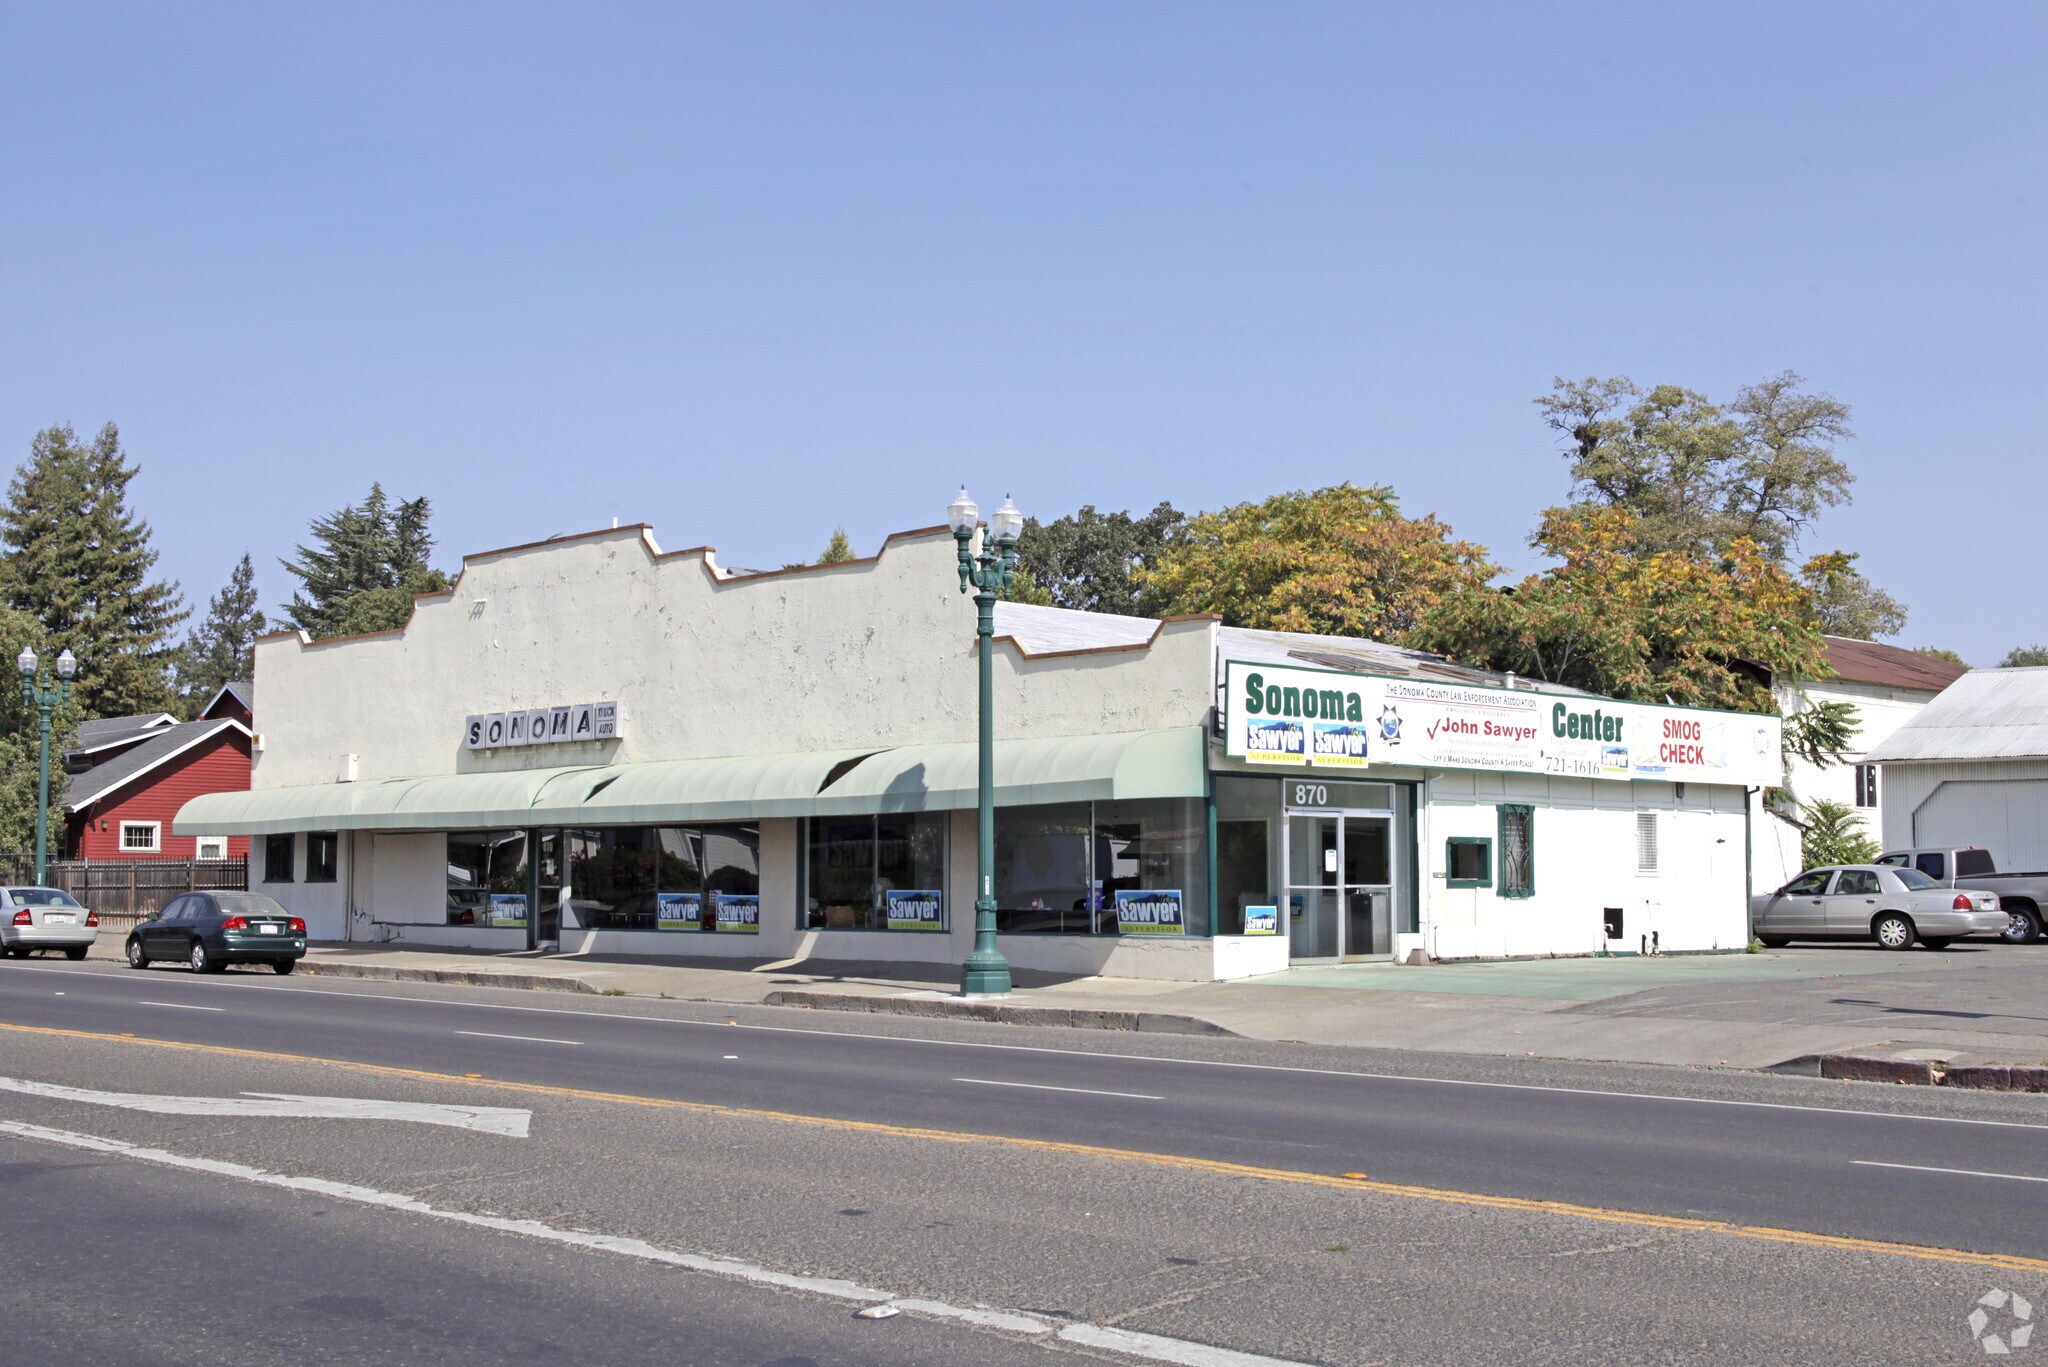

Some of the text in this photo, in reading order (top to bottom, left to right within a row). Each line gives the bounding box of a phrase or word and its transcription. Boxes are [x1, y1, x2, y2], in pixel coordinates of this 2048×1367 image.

[1245, 672, 1363, 723] Sonoma
[1399, 685, 1424, 697] SONOMA
[1426, 687, 1449, 699] COUNTY
[1450, 690, 1462, 700] LAW
[1463, 691, 1502, 704] ENFORCEMENT
[1503, 695, 1537, 708] ASSOCIATION
[469, 710, 591, 745] SONOMA
[1441, 717, 1537, 742] John Sawyer
[1552, 702, 1624, 742] Center
[1663, 718, 1701, 741] SMOG
[1248, 724, 1303, 753] Sawyer
[1314, 728, 1367, 757] Sawyer
[1251, 753, 1302, 762] SUPERVISOR
[1317, 757, 1364, 765] SUPERVISOR
[1461, 756, 1481, 764] SONOMA
[1481, 758, 1499, 766] COUNTY
[1660, 742, 1705, 765] CHECK
[1546, 757, 1600, 775] 721-1616
[1295, 784, 1328, 805] 870
[492, 900, 525, 919] Sawyer
[660, 900, 699, 921] Sawyer
[717, 902, 758, 924] Sawyer
[889, 897, 938, 921] Sawyer
[1119, 898, 1179, 924] Sawyer
[1246, 916, 1275, 930] Sawyer
